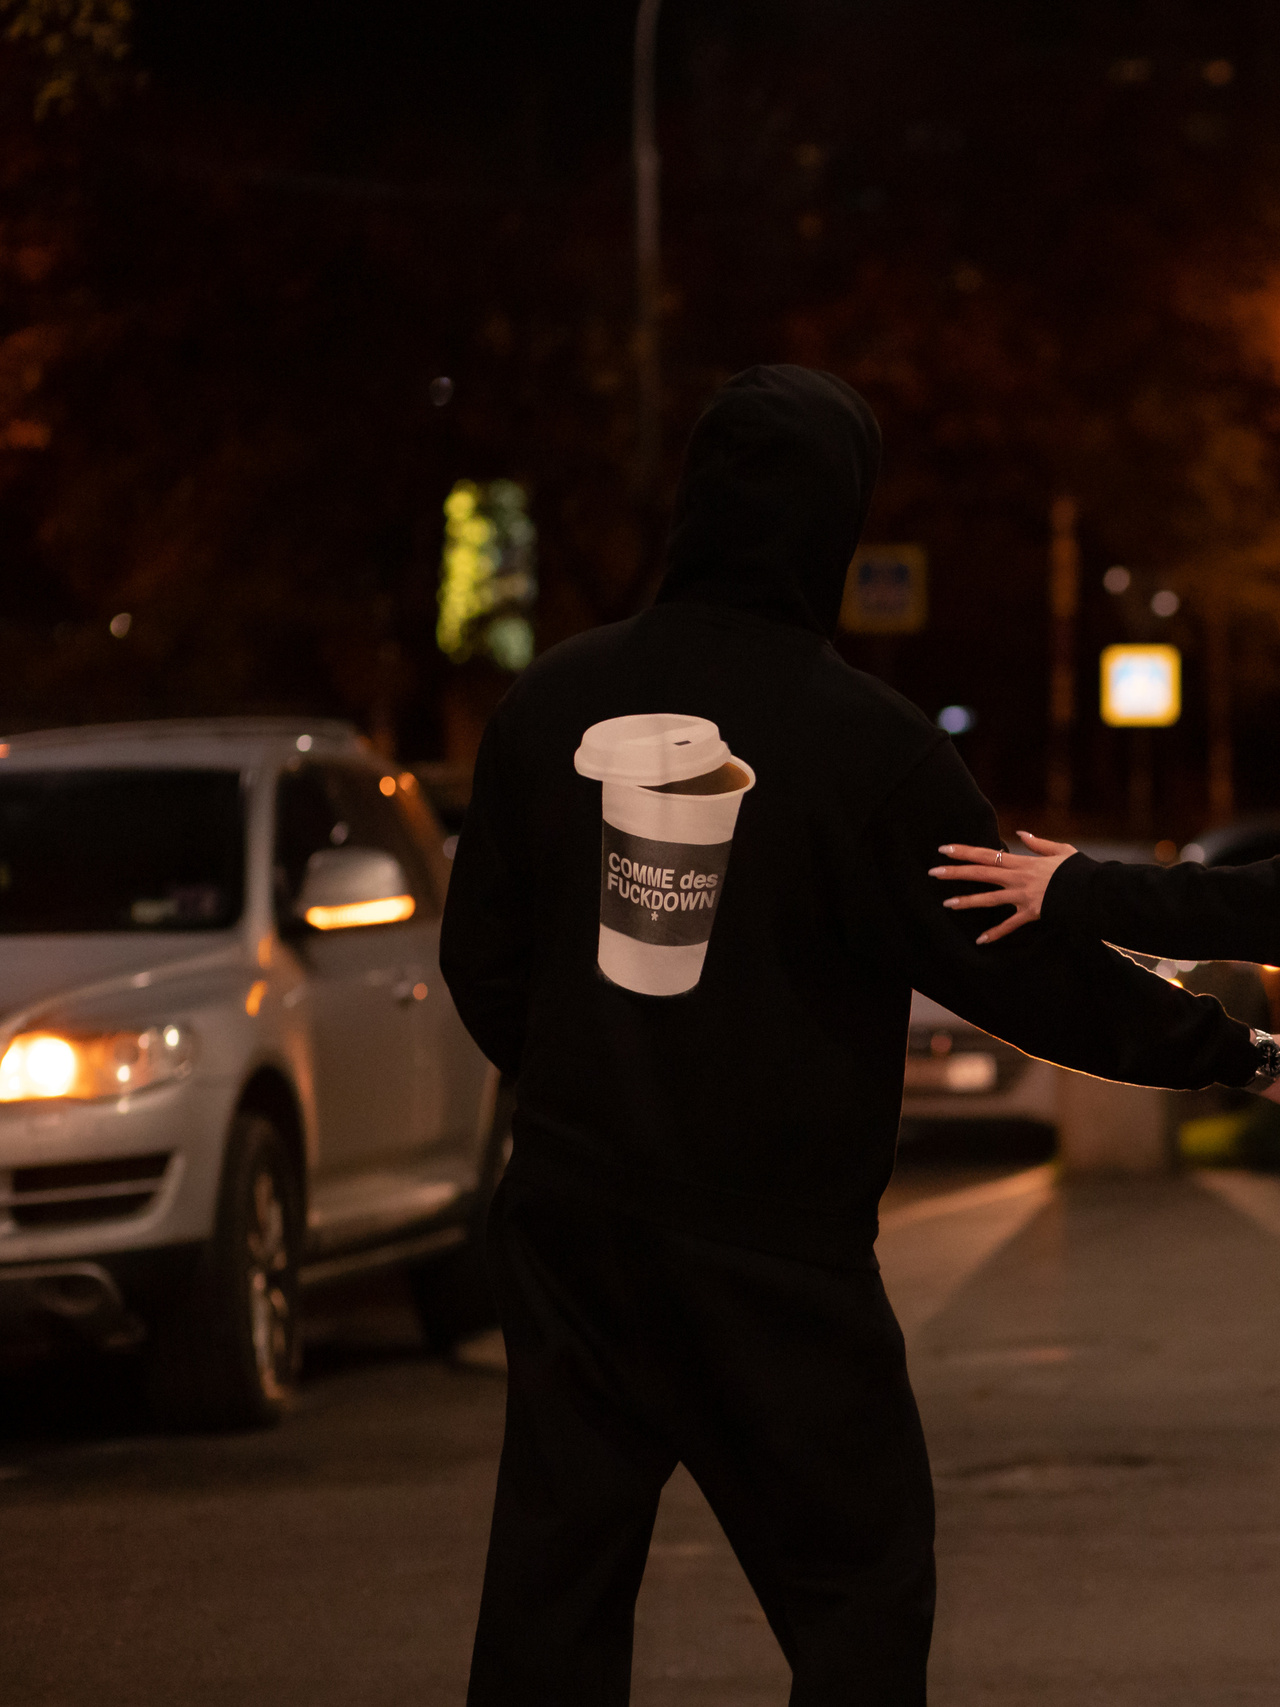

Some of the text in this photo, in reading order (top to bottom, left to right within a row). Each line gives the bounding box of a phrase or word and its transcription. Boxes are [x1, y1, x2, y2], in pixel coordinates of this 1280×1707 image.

[608, 852, 719, 890] COMME des
[607, 872, 716, 912] FUCKDOWN
